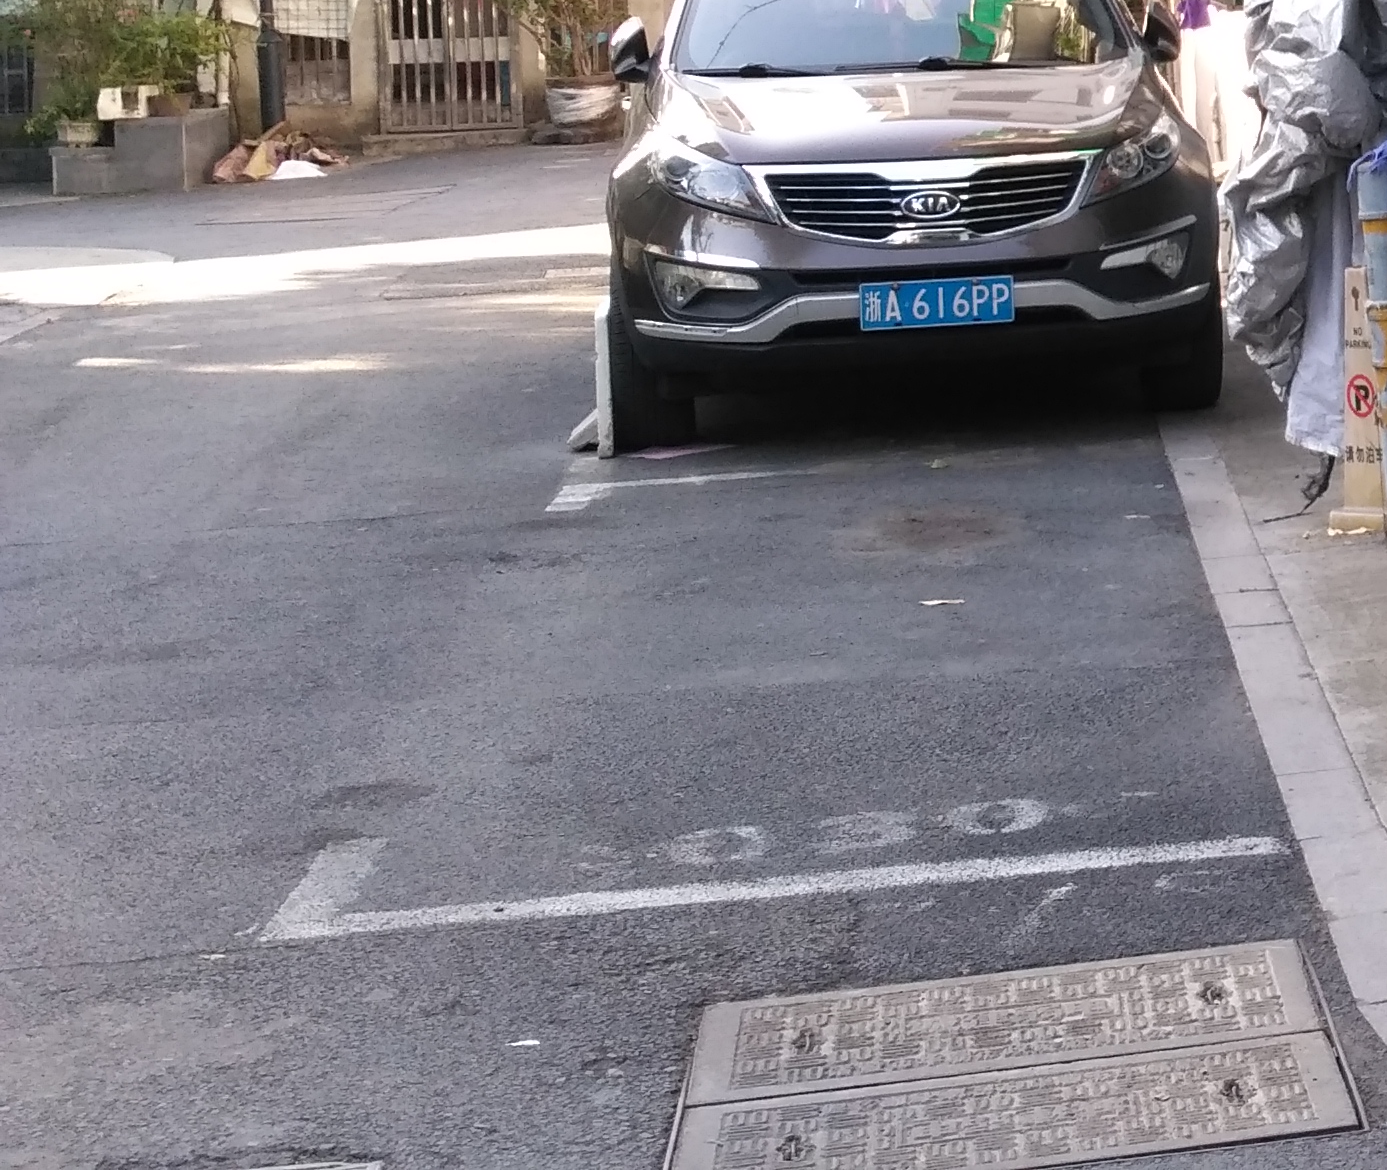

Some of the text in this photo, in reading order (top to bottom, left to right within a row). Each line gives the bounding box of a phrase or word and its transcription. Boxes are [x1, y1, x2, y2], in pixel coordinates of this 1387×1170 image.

[911, 196, 951, 212] KIA
[1352, 327, 1363, 336] NO
[1345, 339, 1372, 349] PARKING
